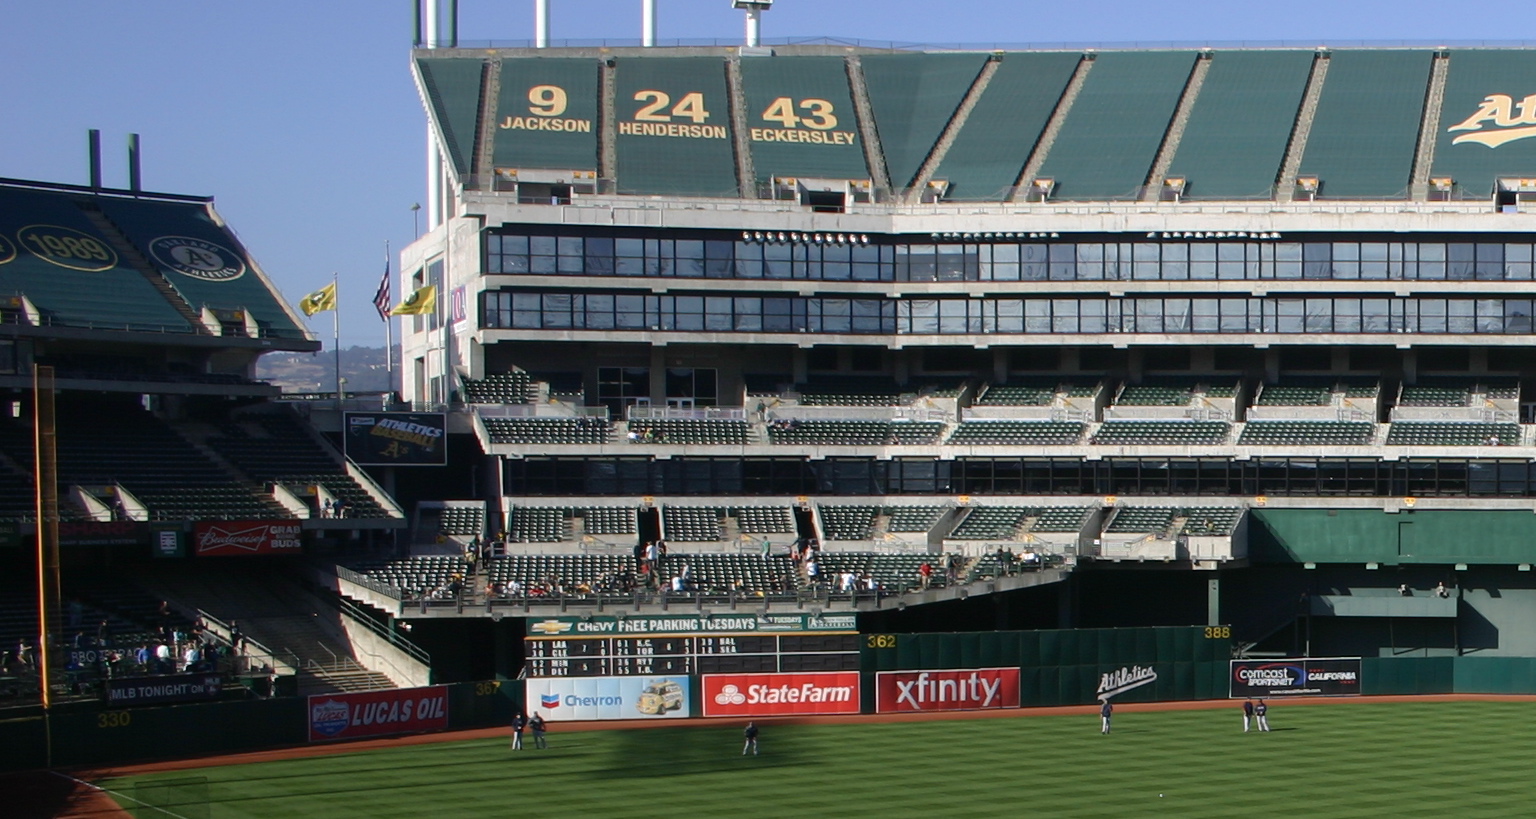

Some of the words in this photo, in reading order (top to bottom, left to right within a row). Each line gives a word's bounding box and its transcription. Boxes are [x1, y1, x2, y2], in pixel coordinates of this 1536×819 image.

[527, 85, 568, 117] 9
[633, 90, 710, 124] 24
[761, 97, 838, 130] 43
[500, 116, 591, 132] JACKSON
[618, 121, 727, 140] HENDERSON
[750, 127, 855, 145] ECKERSLEY
[27, 233, 110, 261] 1989
[157, 239, 221, 252] OAKLAND
[174, 264, 238, 279] ATHLETICS
[380, 418, 444, 438] ATHLETICS
[269, 526, 302, 535] GRAB
[198, 531, 268, 547] Budweiser
[270, 540, 302, 549] BUDS
[577, 622, 616, 633] CHEVY
[618, 620, 648, 633] FREE
[649, 618, 699, 633] PARKING
[699, 618, 757, 631] TUESDAYS
[1204, 627, 1230, 639] 388
[867, 634, 896, 648] 362
[71, 650, 97, 663] BBQ
[1097, 665, 1158, 697] Athletics
[1240, 668, 1289, 679] comcast
[1308, 672, 1357, 681] CALIFORNIA
[476, 681, 501, 696] 367
[1248, 678, 1295, 687] SPORTSNET
[111, 688, 137, 701] MLB
[138, 684, 187, 698] TONIGHT
[190, 685, 205, 694] ON
[896, 672, 1002, 710] xfinity
[564, 694, 623, 707] Chevron
[351, 699, 414, 726] LUCAS
[416, 697, 445, 720] OIL
[97, 711, 131, 729] 330
